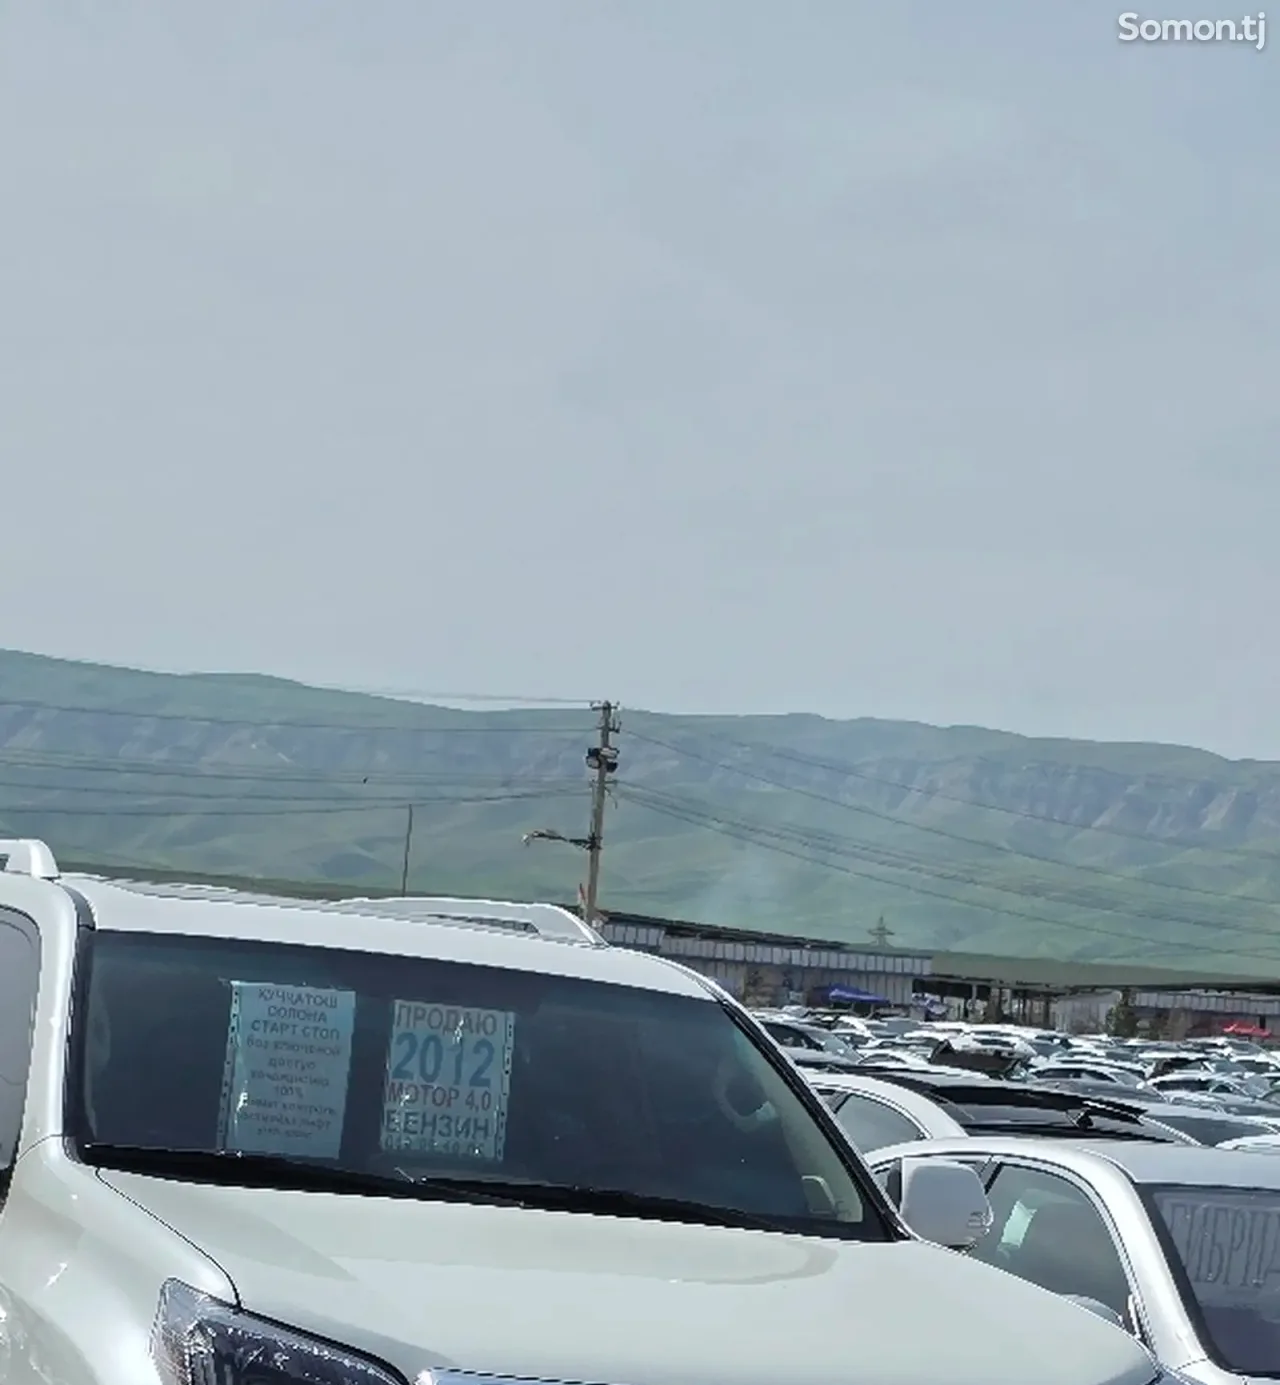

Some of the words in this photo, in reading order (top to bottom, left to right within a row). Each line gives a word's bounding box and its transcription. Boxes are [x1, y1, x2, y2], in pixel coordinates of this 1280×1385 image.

[250, 1019, 299, 1036] СТАРТ
[301, 1025, 340, 1041] СТОП
[396, 1003, 498, 1036] ПРОДАЮ
[391, 1031, 496, 1088] 2012
[386, 1080, 461, 1109] МОТОР
[464, 1088, 492, 1113] 4,0
[385, 1108, 489, 1141] БЕНЗИН
